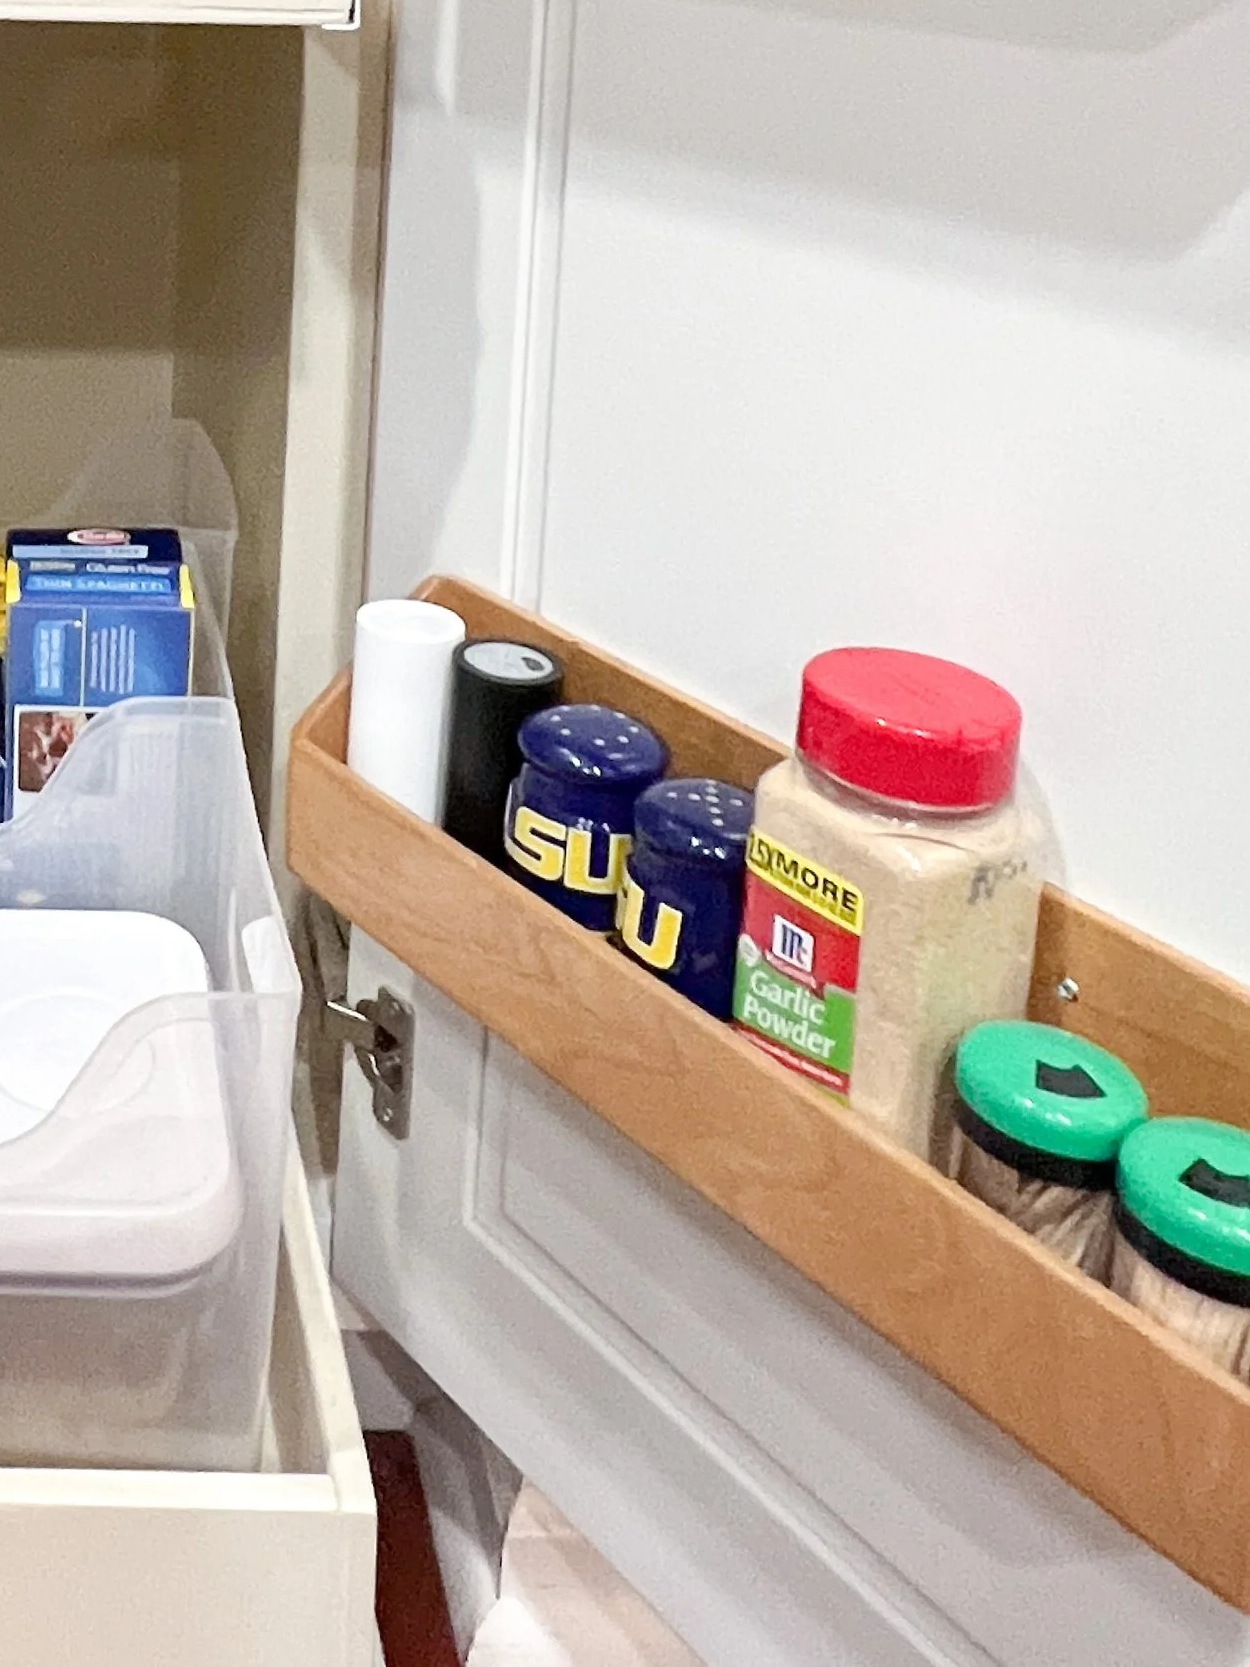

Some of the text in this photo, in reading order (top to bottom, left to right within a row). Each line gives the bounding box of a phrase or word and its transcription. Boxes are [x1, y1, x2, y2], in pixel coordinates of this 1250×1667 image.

[506, 806, 633, 895] SU
[776, 851, 858, 910] MORE
[743, 993, 837, 1059] Powder
[751, 969, 826, 1025] Garlic
